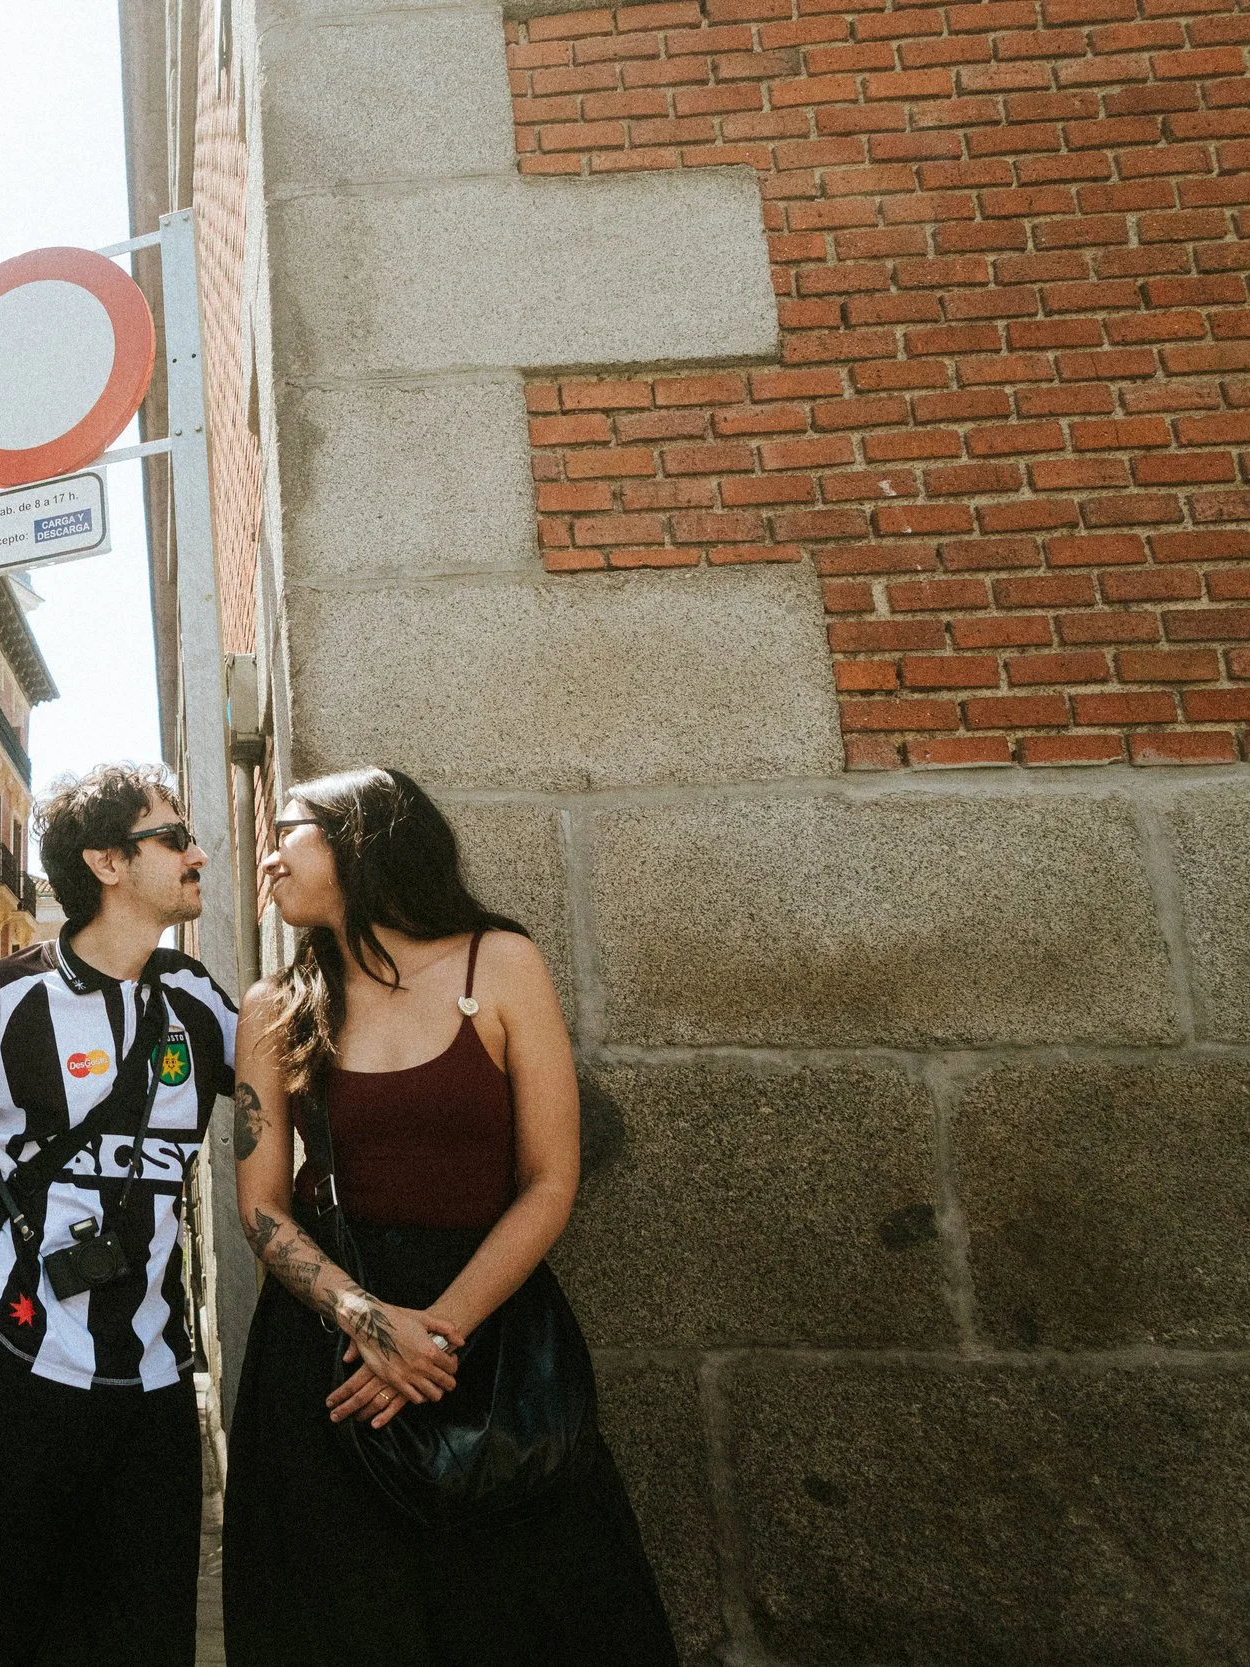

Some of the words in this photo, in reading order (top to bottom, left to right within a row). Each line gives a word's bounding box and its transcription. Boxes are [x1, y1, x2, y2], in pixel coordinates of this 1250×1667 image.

[18, 503, 32, 512] de
[34, 499, 41, 509] 8
[43, 499, 51, 507] a
[53, 493, 66, 504] 17
[68, 491, 79, 501] h.
[41, 516, 75, 529] CARGA
[77, 513, 84, 523] Y
[36, 522, 90, 542] DESCARGA
